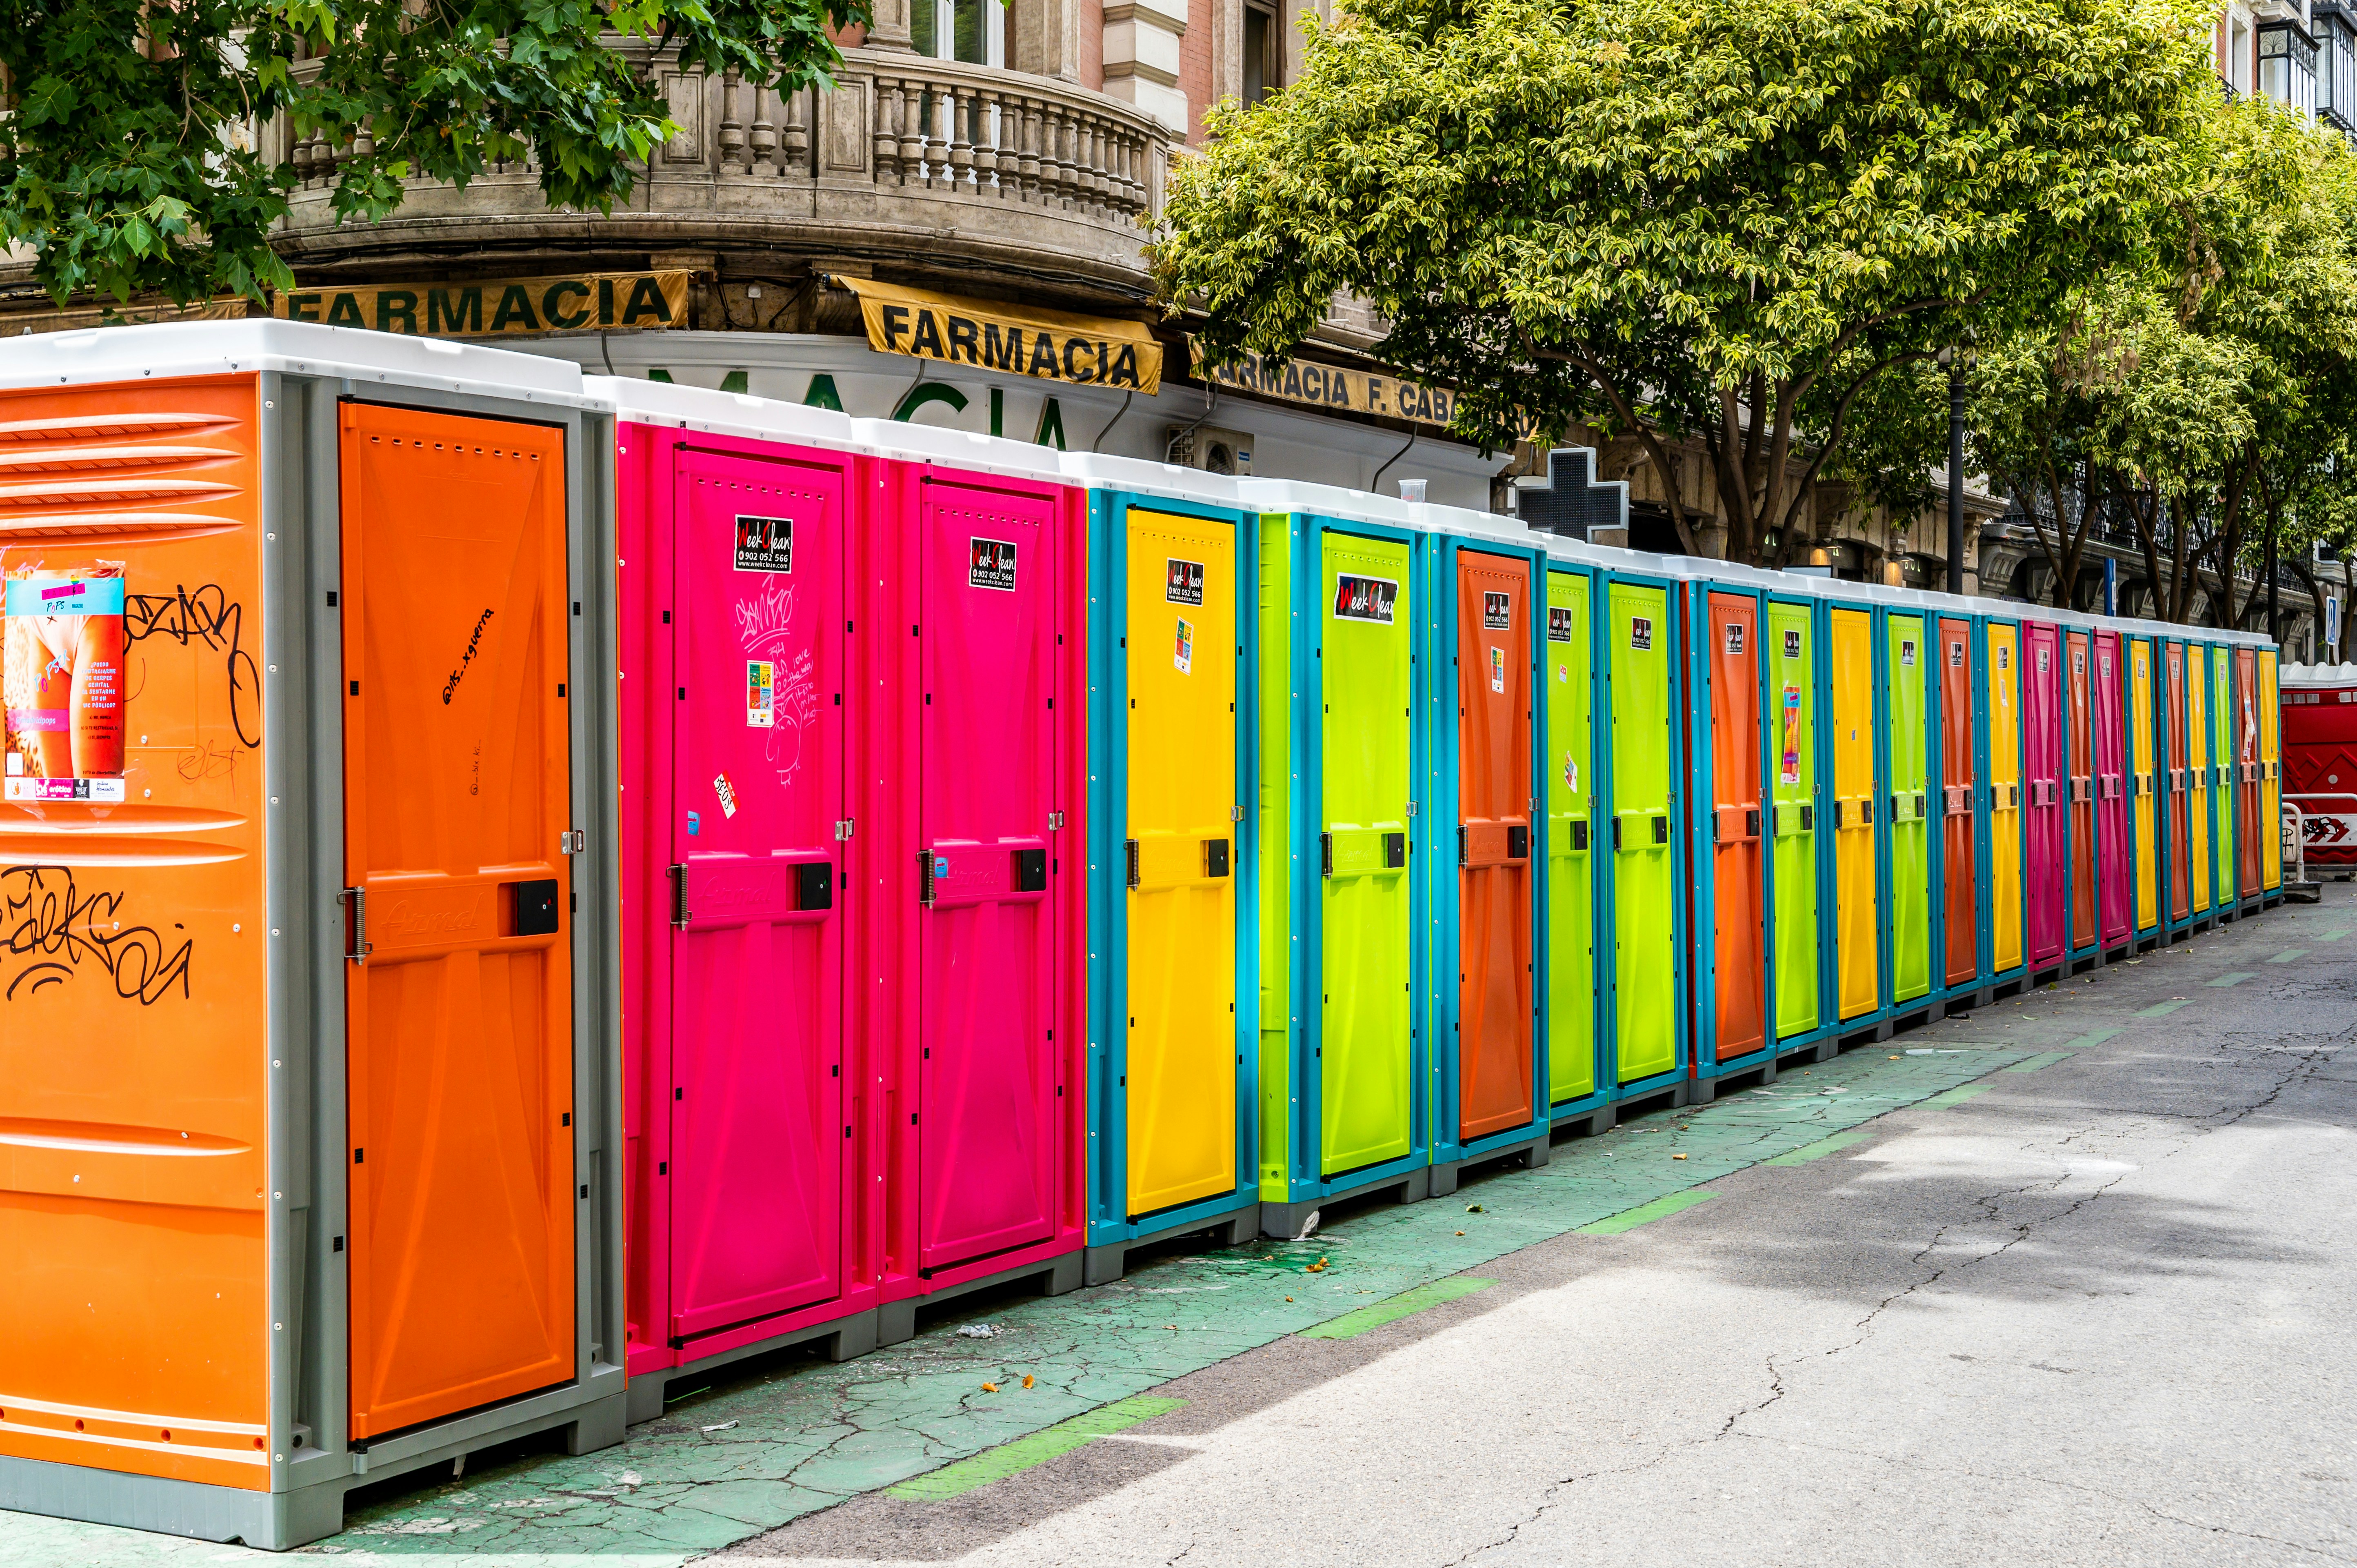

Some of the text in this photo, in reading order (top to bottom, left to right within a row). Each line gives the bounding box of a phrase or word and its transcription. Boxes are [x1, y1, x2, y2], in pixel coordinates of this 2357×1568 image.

[288, 277, 673, 334] FARMACIA
[883, 304, 1139, 388] FARMACIA
[1368, 378, 1386, 411] F.
[745, 552, 788, 562] 902 052 566
[973, 578, 1012, 586] www.weekclean.com
[47, 601, 64, 613] POPS
[2329, 602, 2334, 638] P
[34, 649, 70, 692] POPSEX
[16, 716, 56, 726] @madridpops
